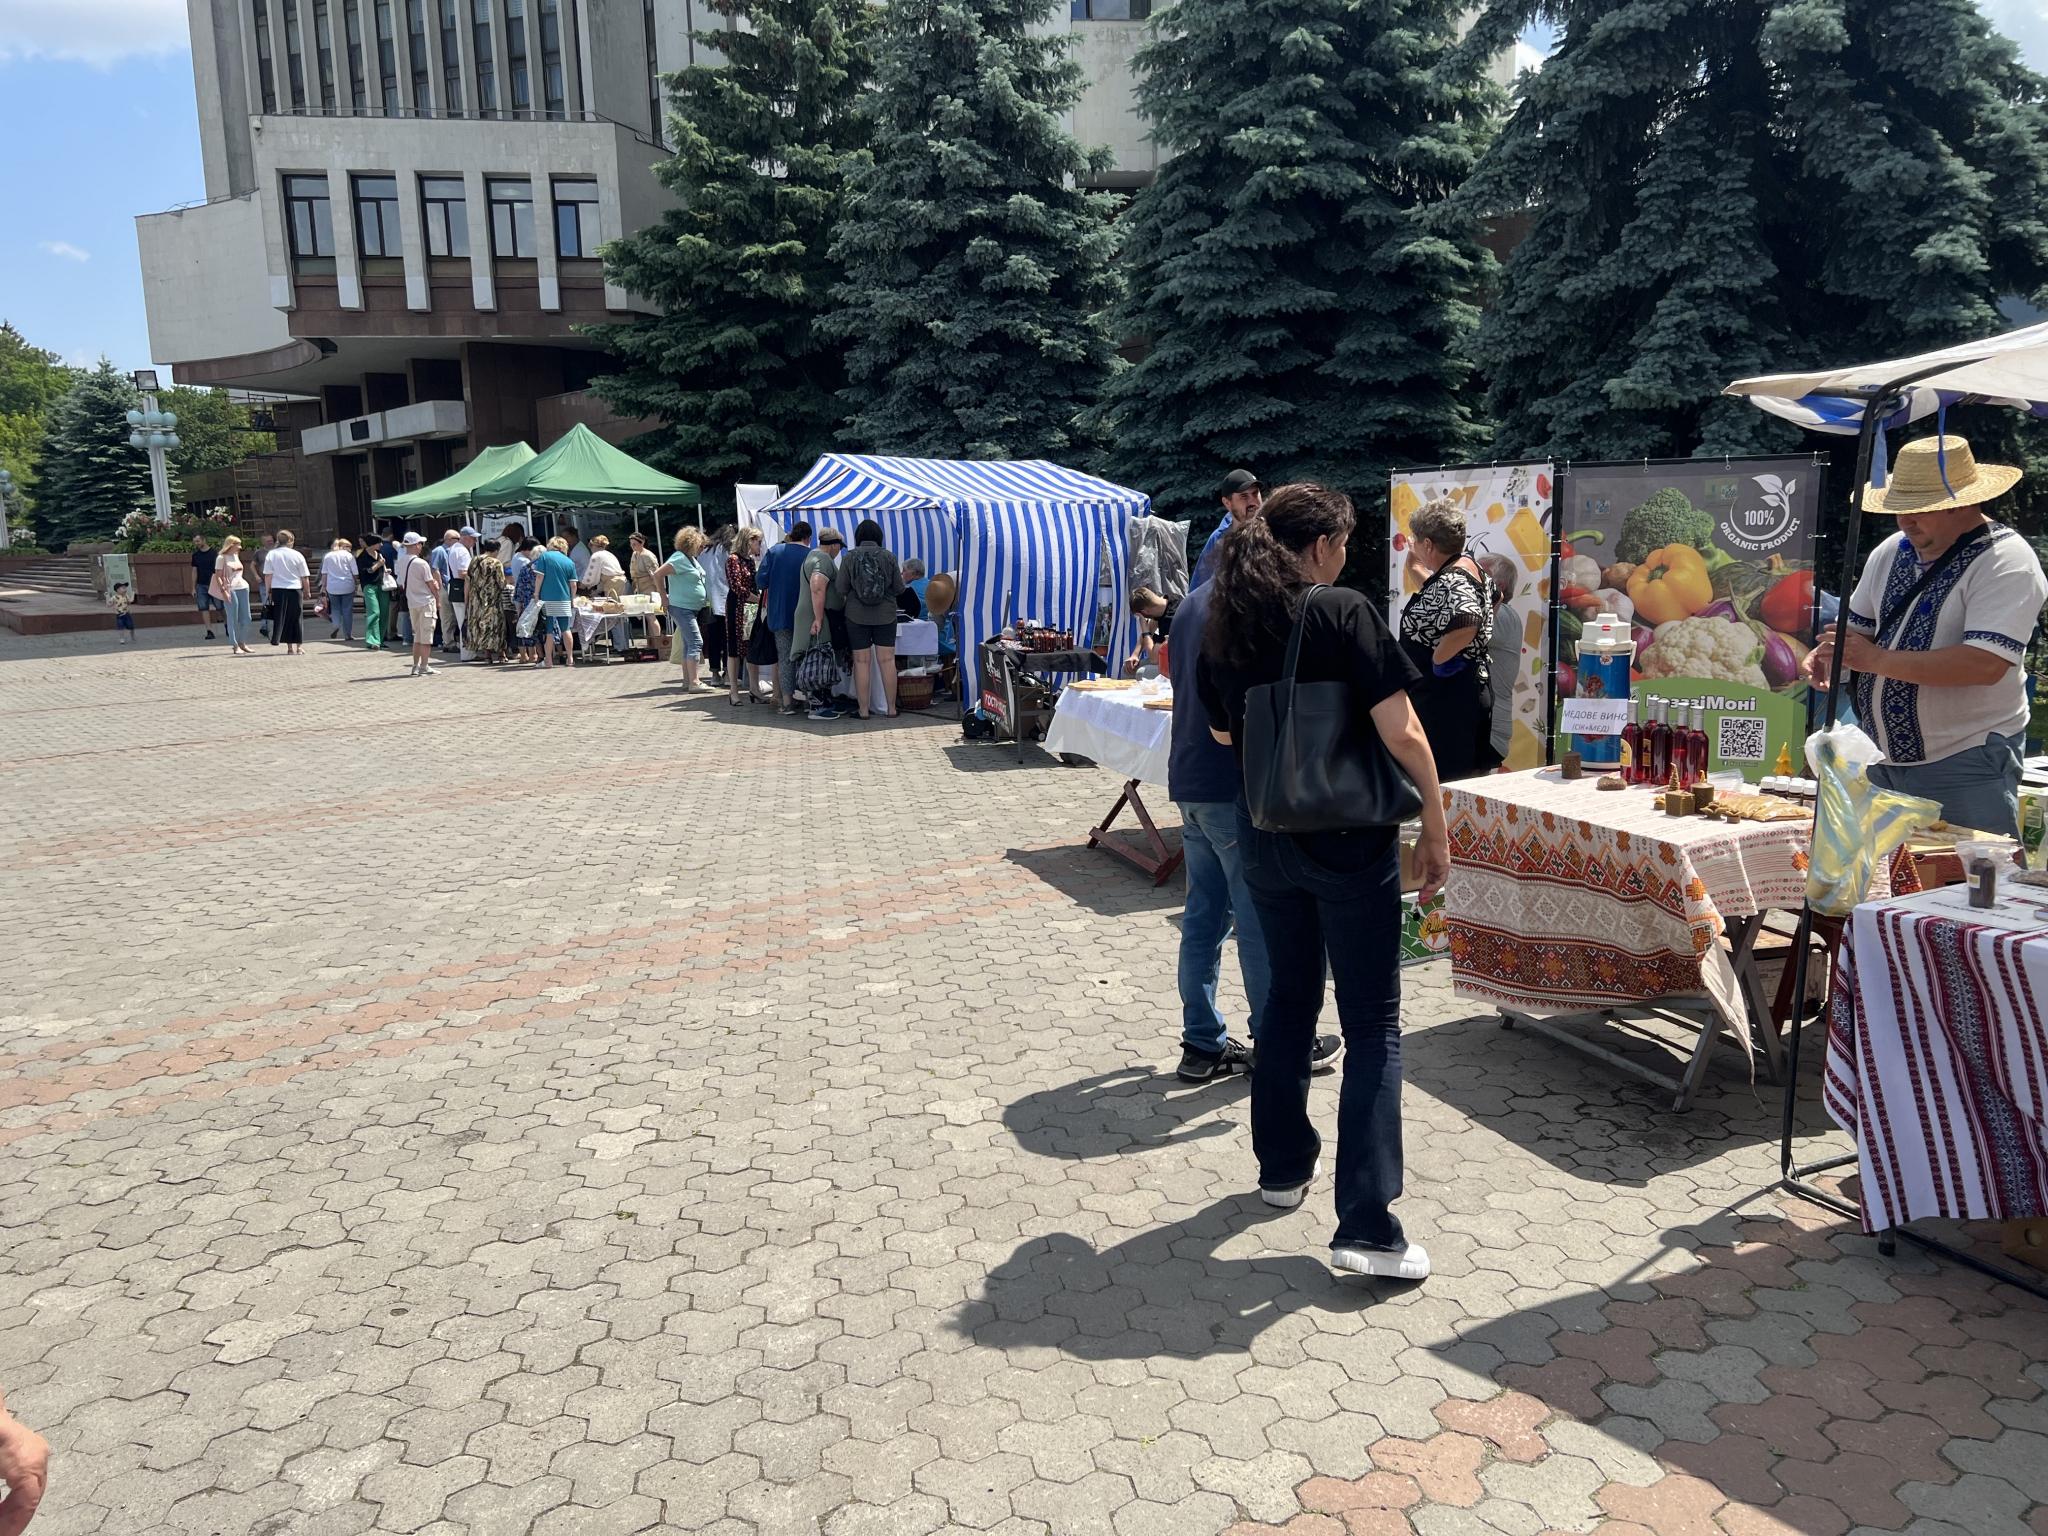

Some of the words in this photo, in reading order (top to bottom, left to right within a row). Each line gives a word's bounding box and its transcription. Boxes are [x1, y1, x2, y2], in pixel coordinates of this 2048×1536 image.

[1744, 510, 1775, 526] 100%
[1720, 522, 1758, 551] ORGANIC
[1760, 518, 1801, 551] PRODUCT
[1563, 710, 1599, 720] МЕДОВЕ
[1600, 712, 1629, 721] ВИНО
